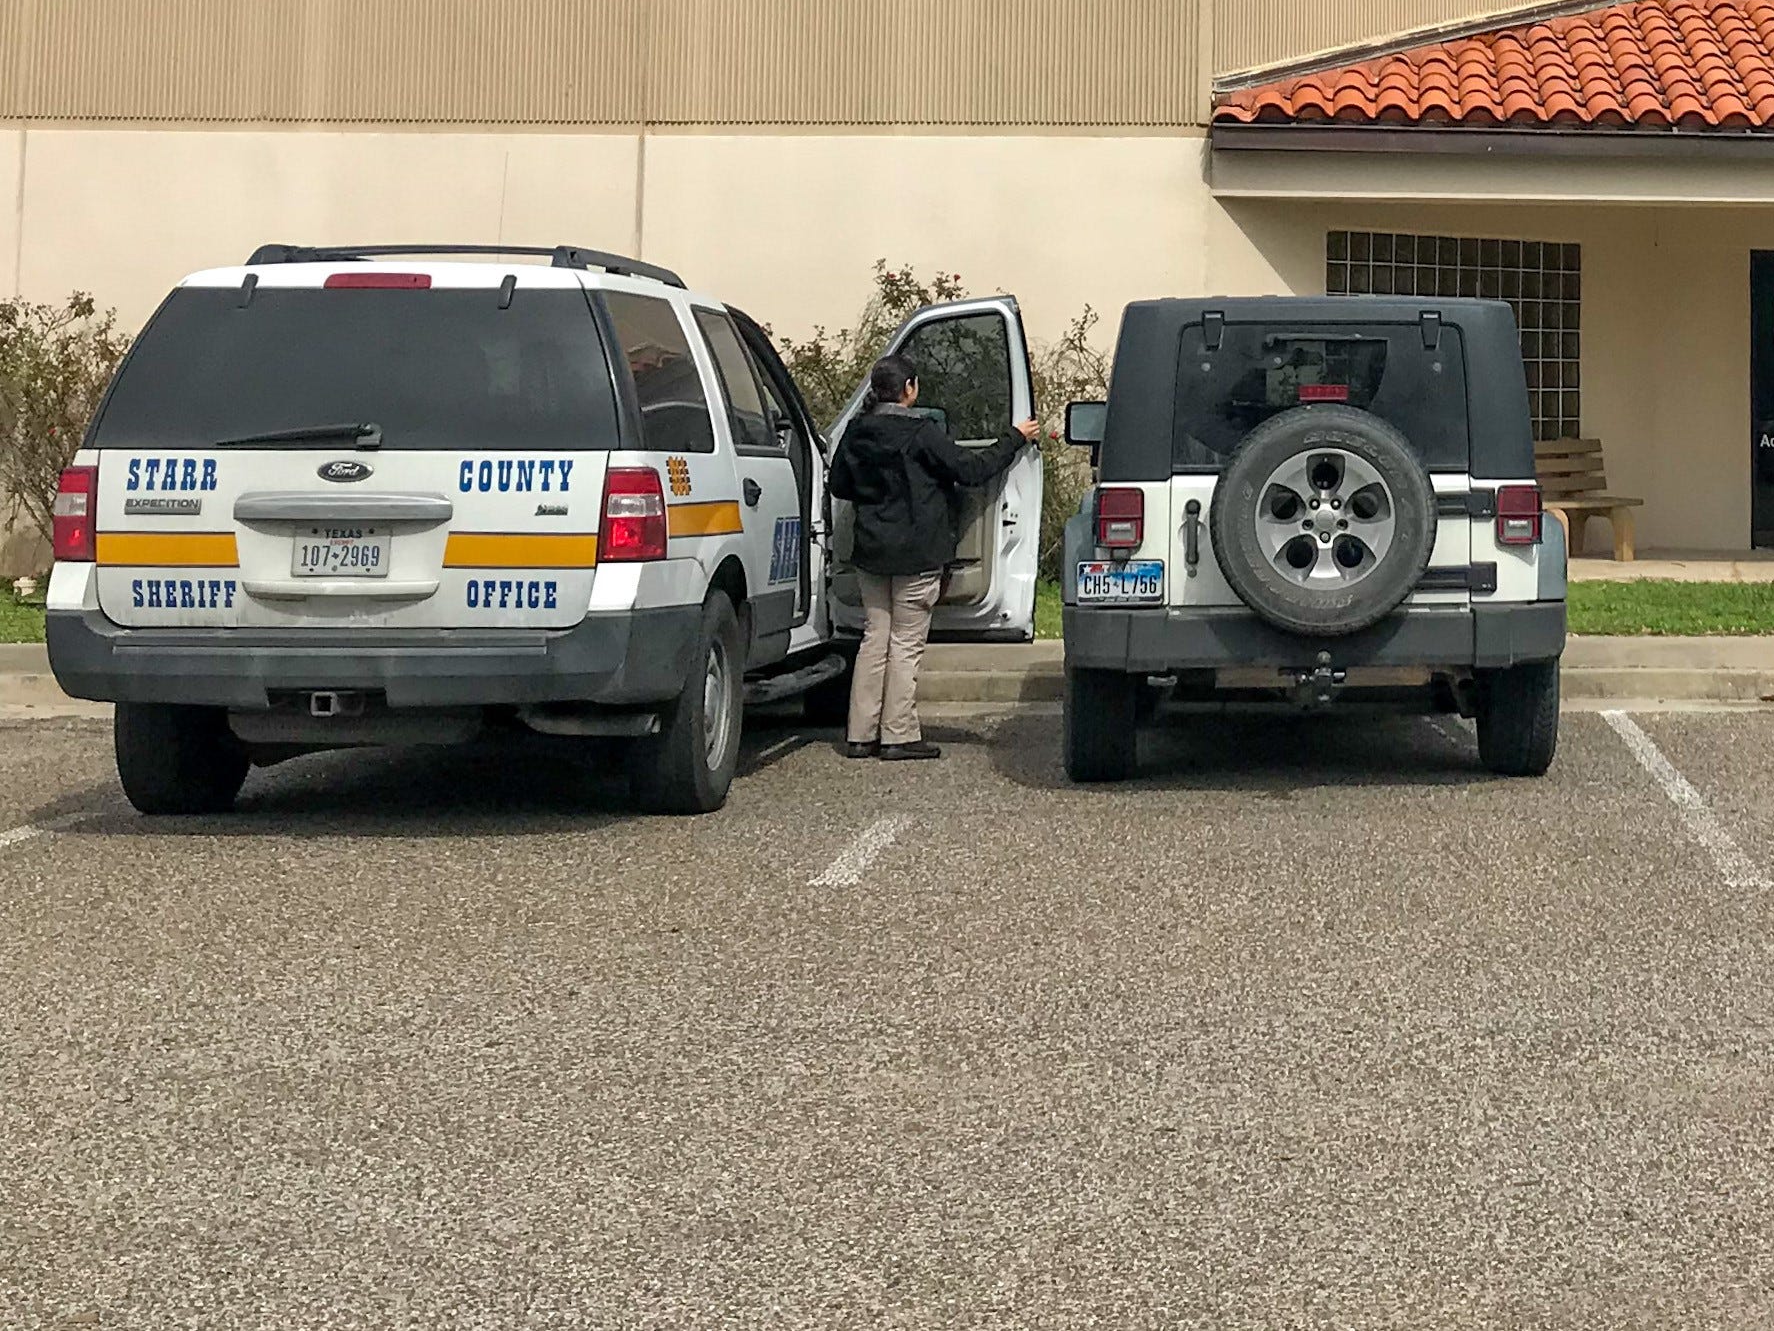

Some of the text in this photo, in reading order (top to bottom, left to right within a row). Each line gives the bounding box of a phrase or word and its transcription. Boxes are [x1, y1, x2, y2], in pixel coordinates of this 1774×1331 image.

[126, 458, 218, 491] STARR
[328, 463, 360, 476] Ford
[459, 460, 574, 492] COUNTY
[324, 529, 362, 539] TEXAS
[340, 545, 380, 567] 2969
[132, 579, 237, 608] SHERIFF
[467, 580, 557, 609] OFFICE
[1084, 575, 1157, 594] CH5 L756
